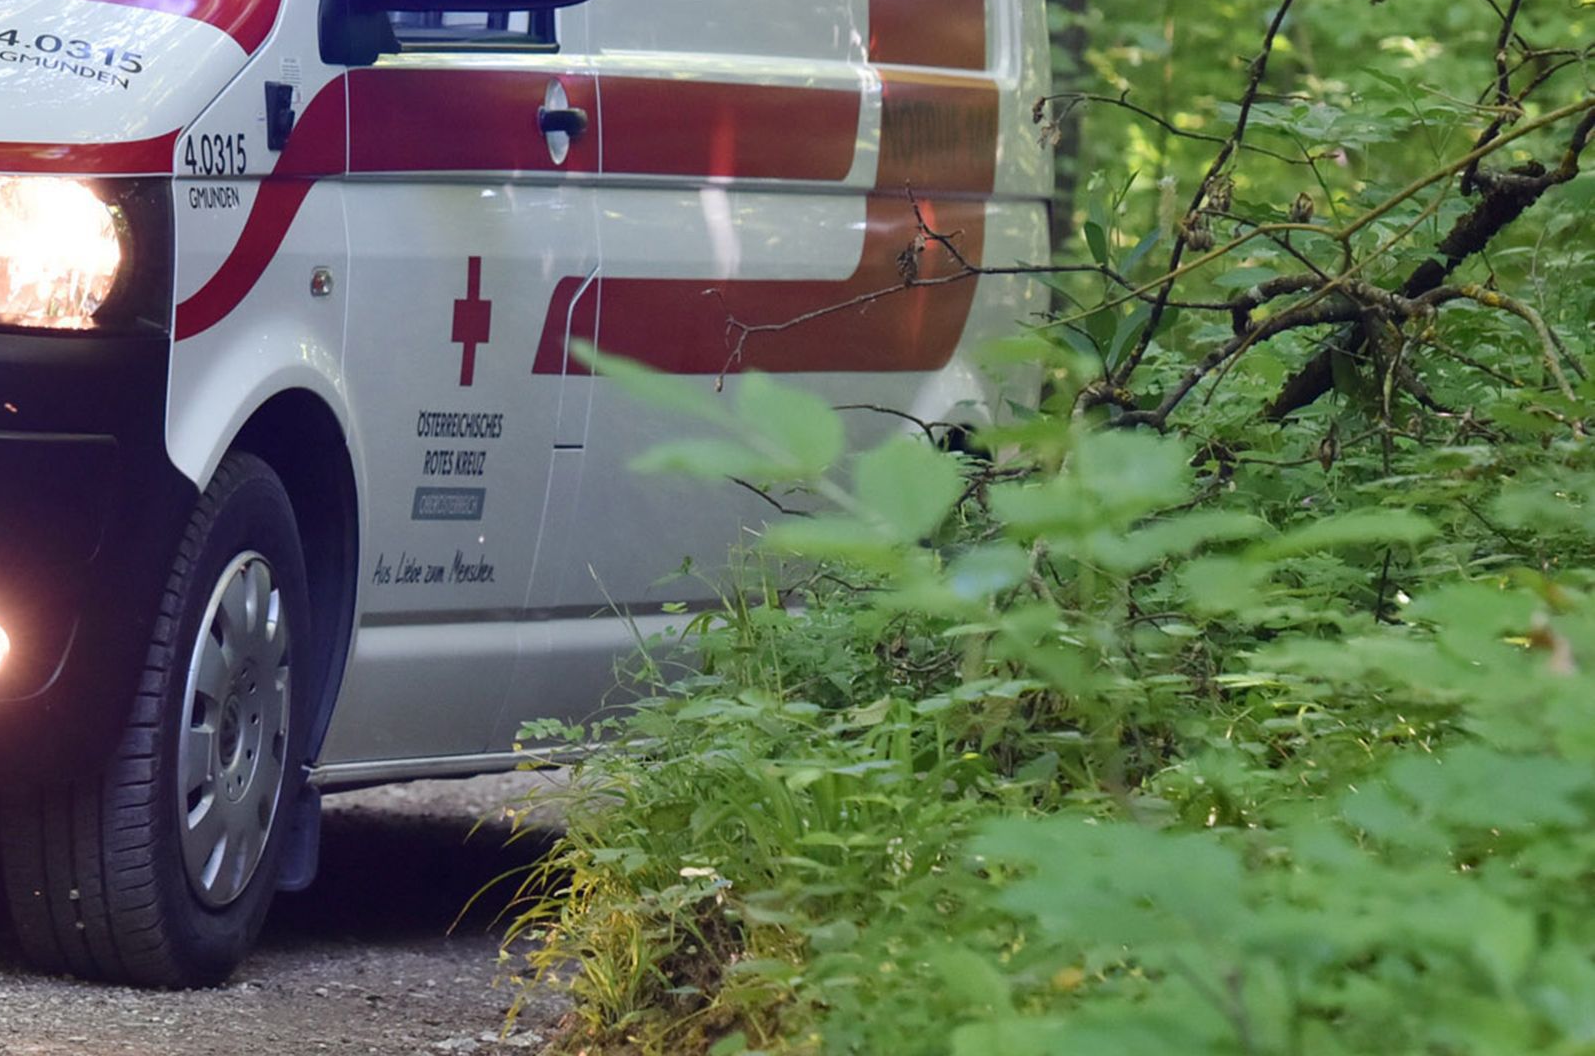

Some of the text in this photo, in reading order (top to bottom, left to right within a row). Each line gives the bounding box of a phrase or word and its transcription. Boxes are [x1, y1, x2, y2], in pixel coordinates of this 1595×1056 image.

[0, 51, 129, 90] GMUNDEN
[184, 133, 246, 175] 4.0315
[189, 187, 240, 209] GMUNDEN
[417, 410, 503, 438] ÖSTERREICHISCHES
[423, 450, 486, 476] ROTES KREUZ
